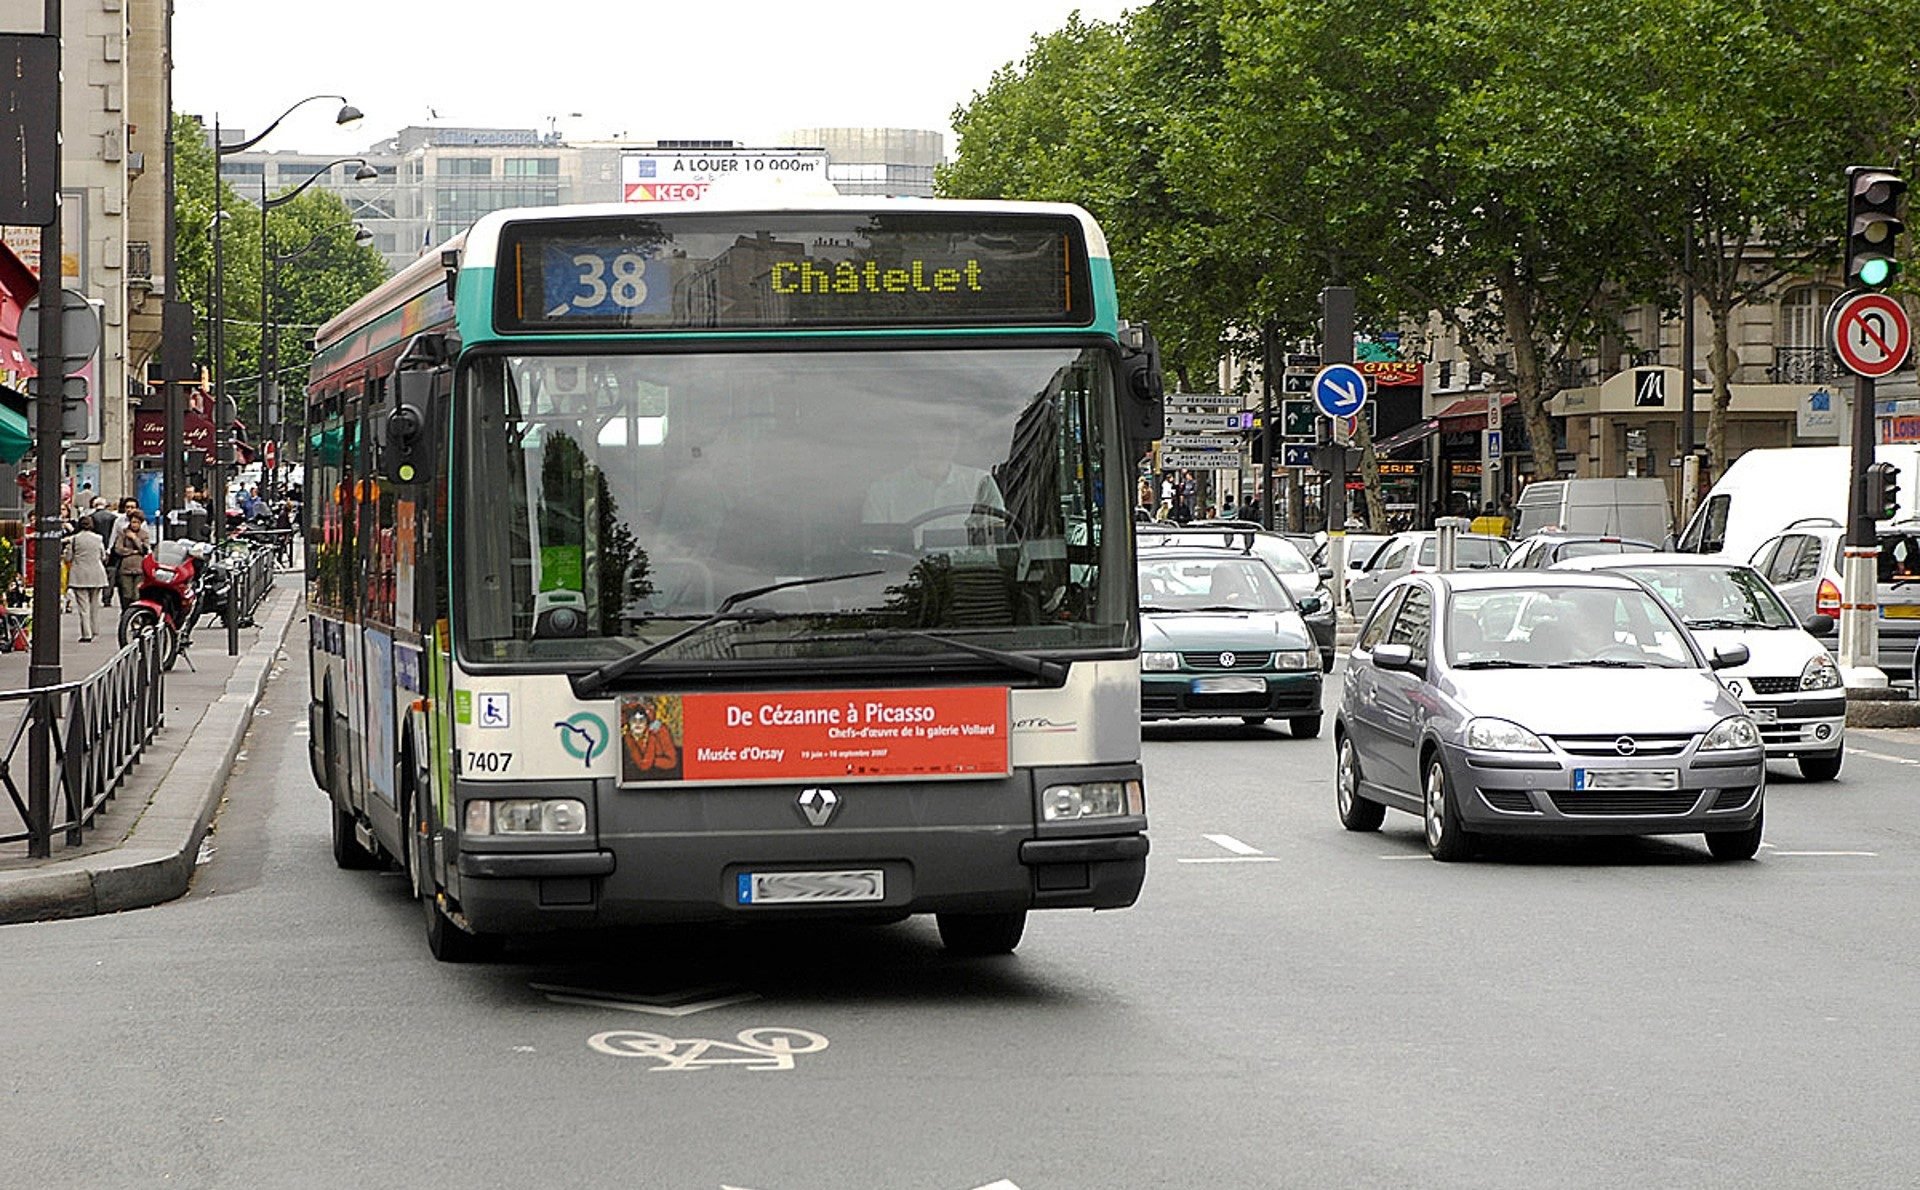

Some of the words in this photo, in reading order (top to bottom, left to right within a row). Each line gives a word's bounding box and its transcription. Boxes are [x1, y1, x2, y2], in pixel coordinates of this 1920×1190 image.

[690, 159, 738, 172] LOUER
[745, 159, 764, 172] 10
[572, 254, 648, 308] 38
[771, 259, 982, 294] Châtelet
[727, 706, 753, 726] De
[759, 704, 840, 725] Cézanne
[847, 702, 858, 723] à
[865, 702, 935, 722] Picasso
[901, 725, 913, 737] de
[915, 725, 925, 736] la
[927, 725, 959, 739] galerie
[961, 724, 995, 736] Vollard
[468, 752, 513, 772] 7407
[697, 748, 737, 761] Musée
[739, 746, 785, 762] d'Orsay
